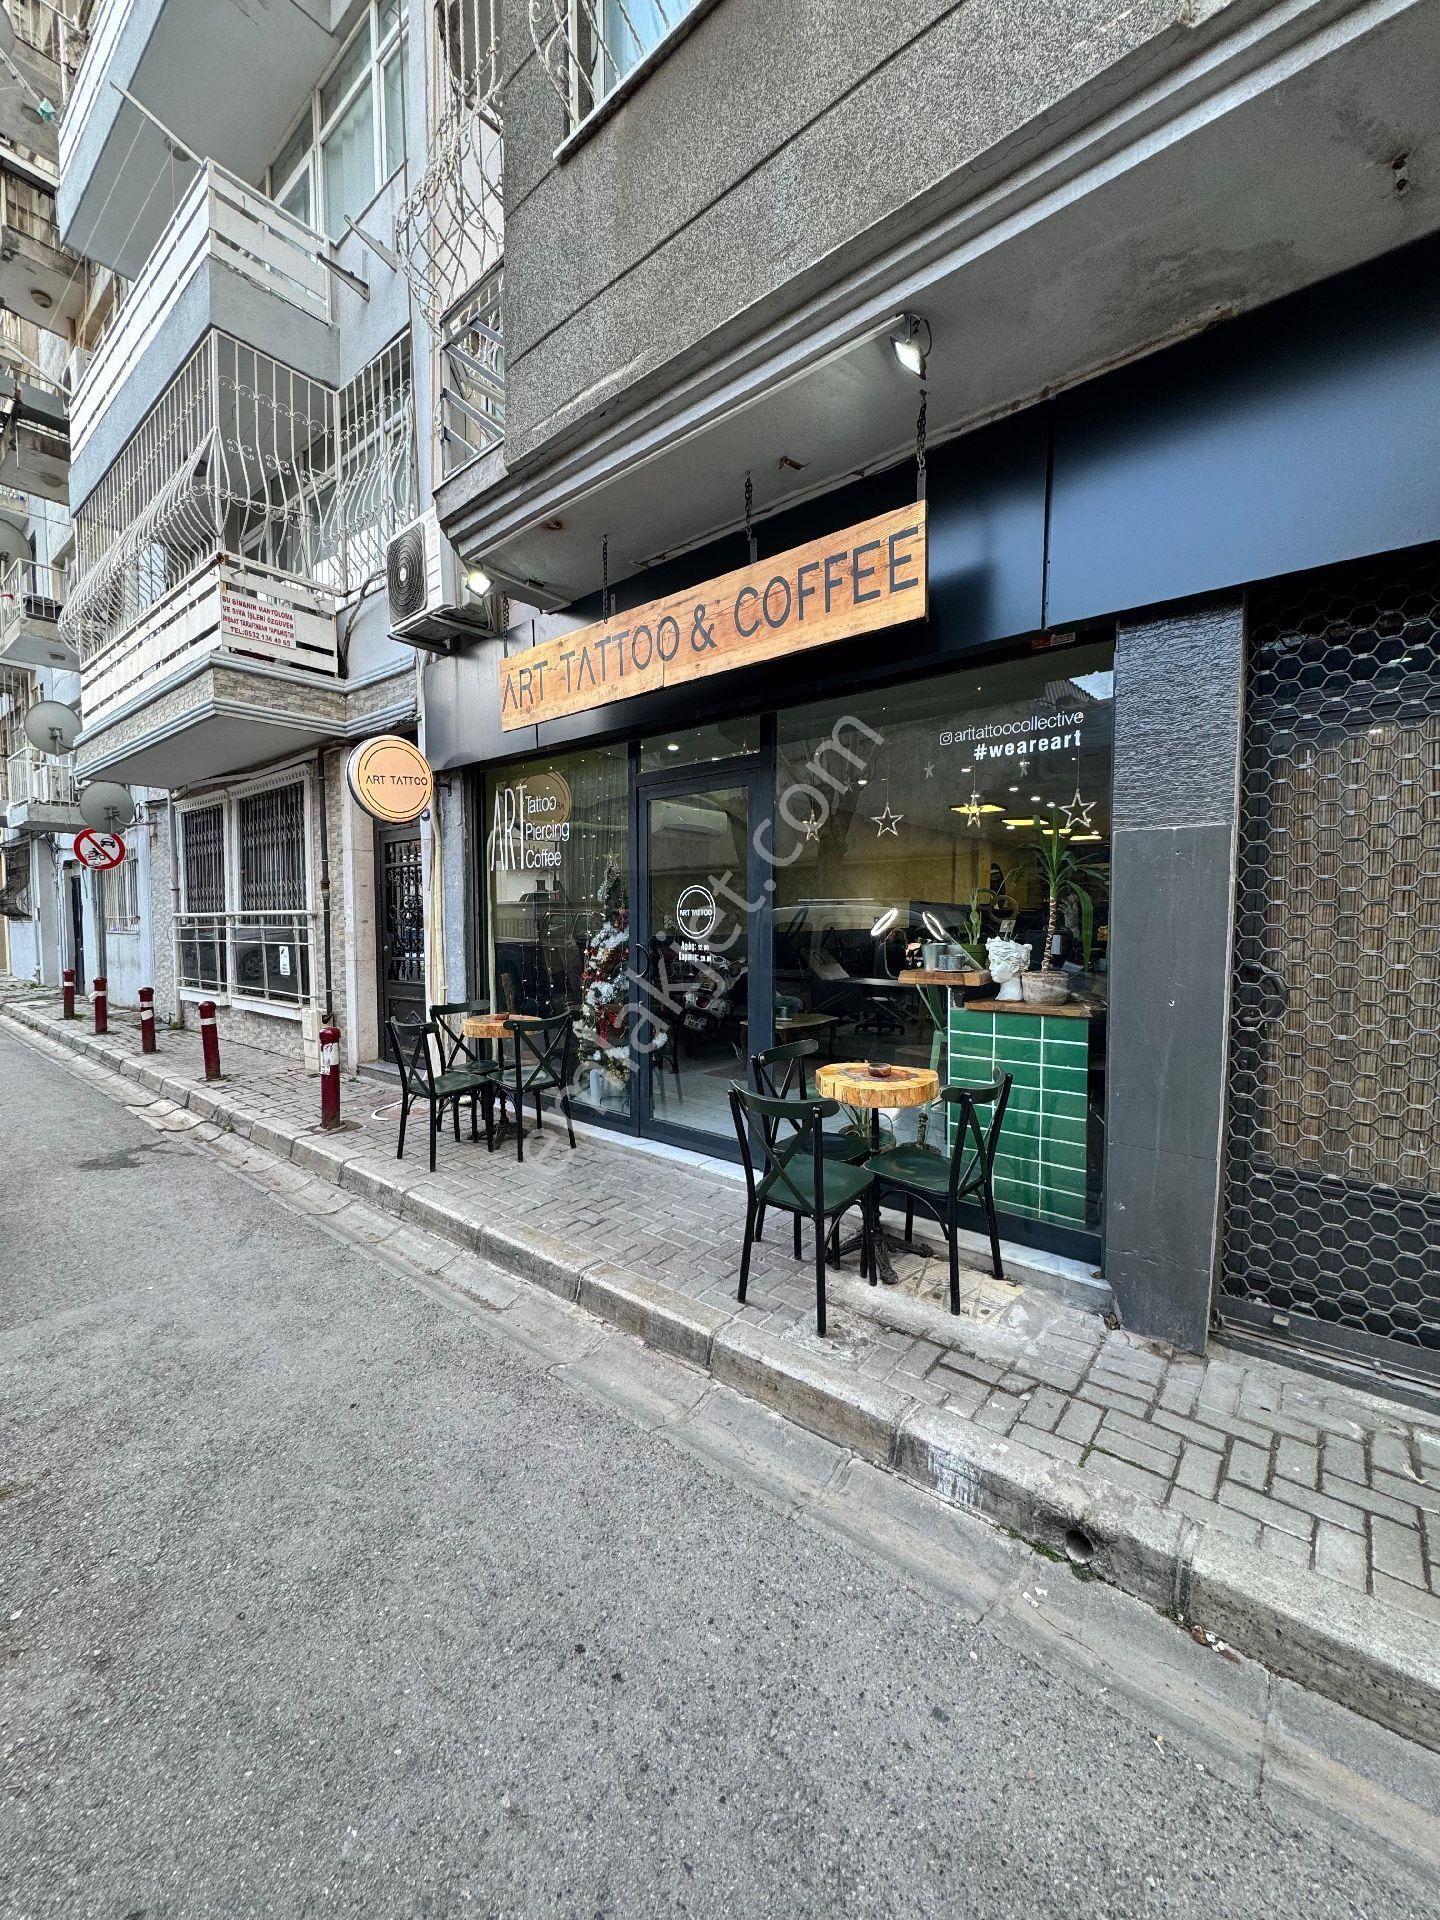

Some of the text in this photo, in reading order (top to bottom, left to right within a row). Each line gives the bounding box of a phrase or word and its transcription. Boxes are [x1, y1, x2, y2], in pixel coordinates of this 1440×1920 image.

[222, 596, 231, 604] BU
[258, 606, 293, 621] MANTOLOMA
[222, 605, 231, 613] VE
[232, 608, 246, 617] SIVA
[502, 526, 919, 712] ART TATTOO & COFFEE
[954, 711, 1084, 742] arttattoocollective
[973, 729, 1081, 760] #weareart
[366, 775, 428, 786] ART TATTOO
[525, 795, 557, 814] Tattoo
[491, 784, 527, 871] ART
[525, 822, 570, 841] Piercing
[525, 848, 562, 868] Coffee
[680, 909, 690, 917] ART
